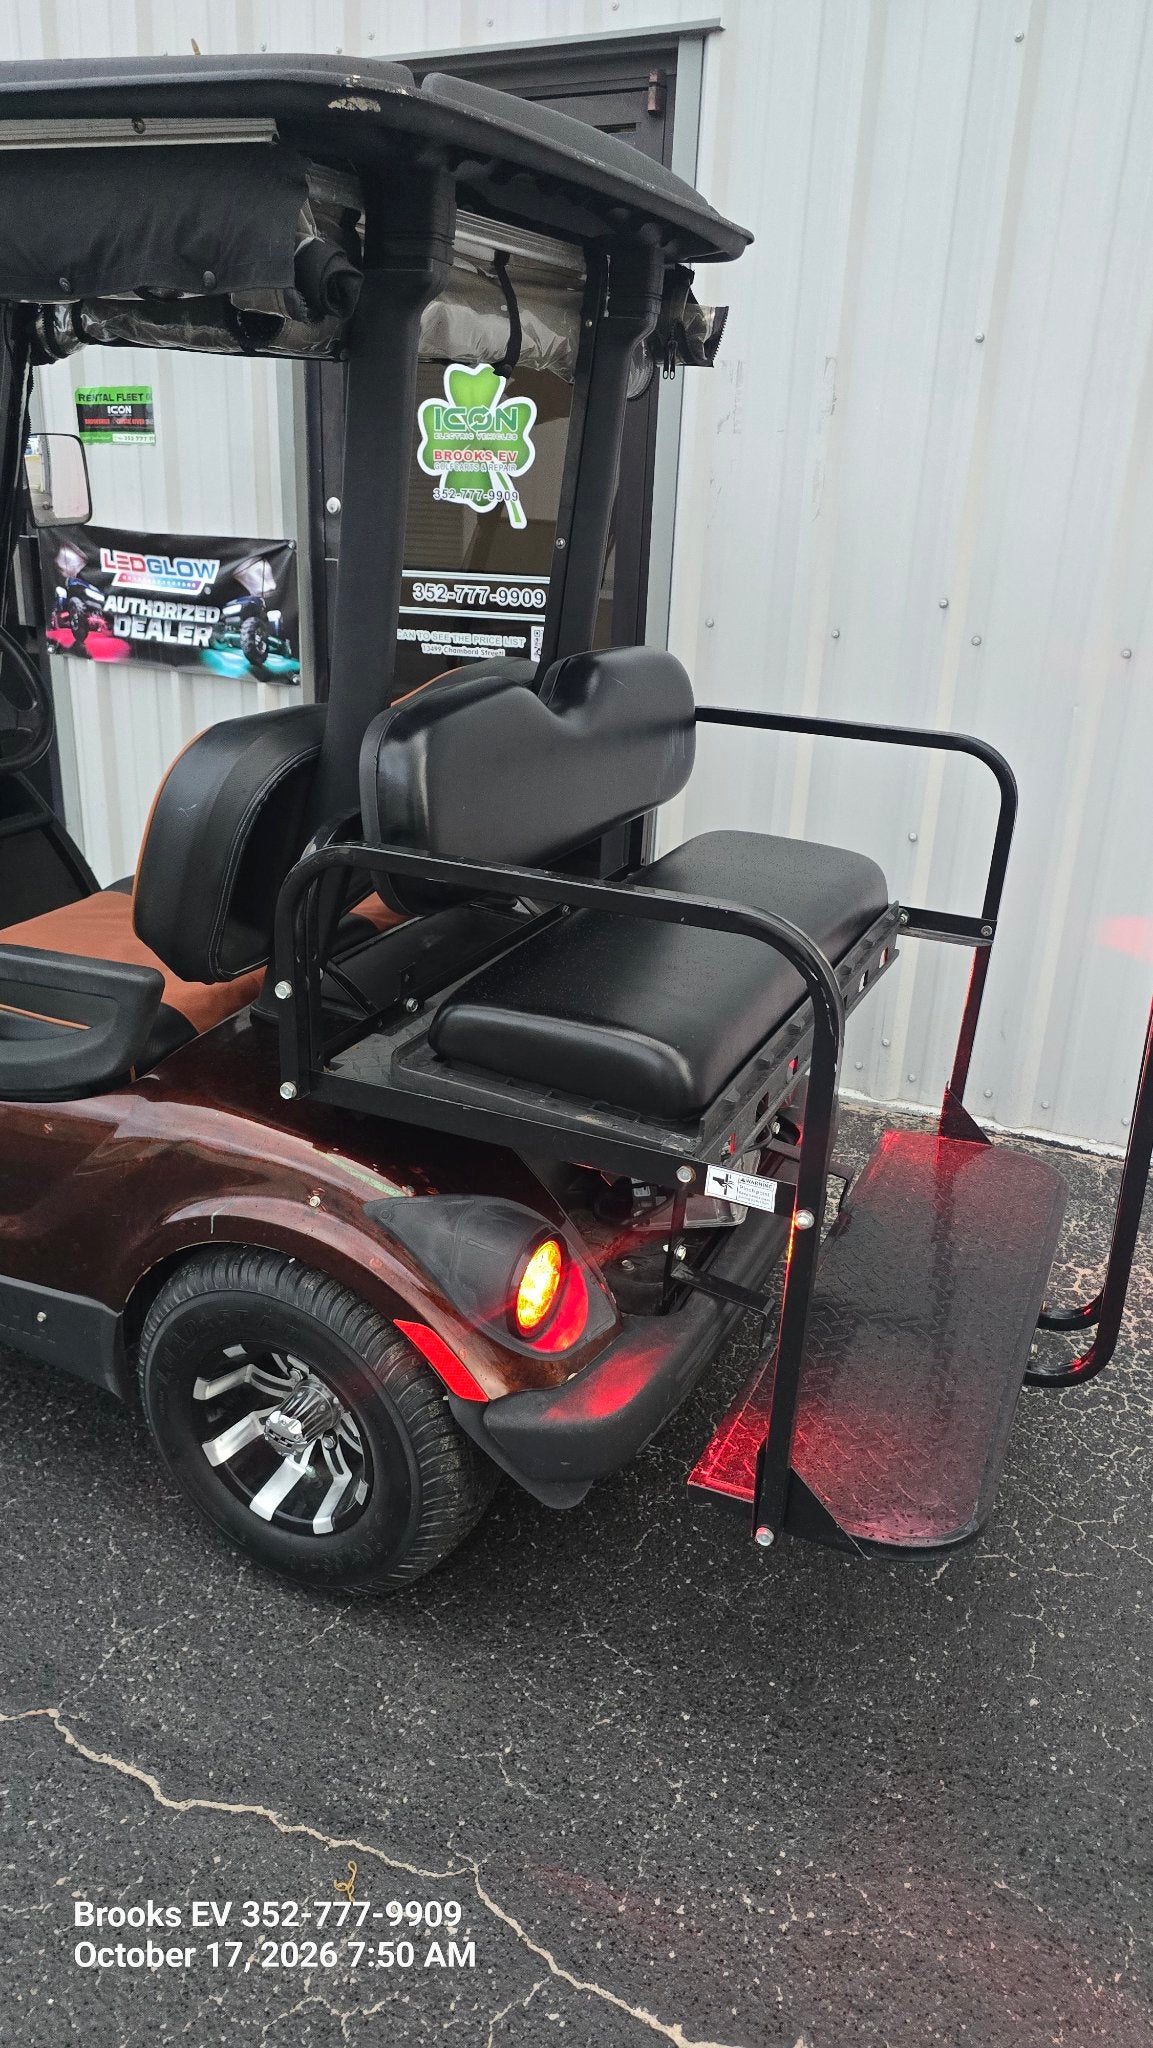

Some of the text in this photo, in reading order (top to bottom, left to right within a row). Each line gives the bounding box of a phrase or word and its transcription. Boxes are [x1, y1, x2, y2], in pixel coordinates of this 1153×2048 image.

[78, 393, 114, 402] RENTAL
[117, 393, 144, 401] FLEET
[107, 405, 132, 414] ICON
[434, 405, 518, 433] ICON
[434, 432, 518, 441] ELECTRIC VEHICLES
[434, 450, 518, 462] BROOKS EV
[488, 463, 517, 472] REPAIR
[433, 488, 519, 502] 352-777-9909
[103, 551, 218, 580] LEDGLOW
[413, 583, 546, 608] 352-777-9909
[103, 595, 221, 623] AUTHORIZED
[114, 615, 213, 647] DEALER
[416, 630, 431, 642] TO
[432, 631, 451, 643] SEE
[452, 632, 471, 644] THE
[472, 634, 501, 646] PRICE
[503, 635, 525, 648] LIST
[443, 646, 479, 656] Chambord
